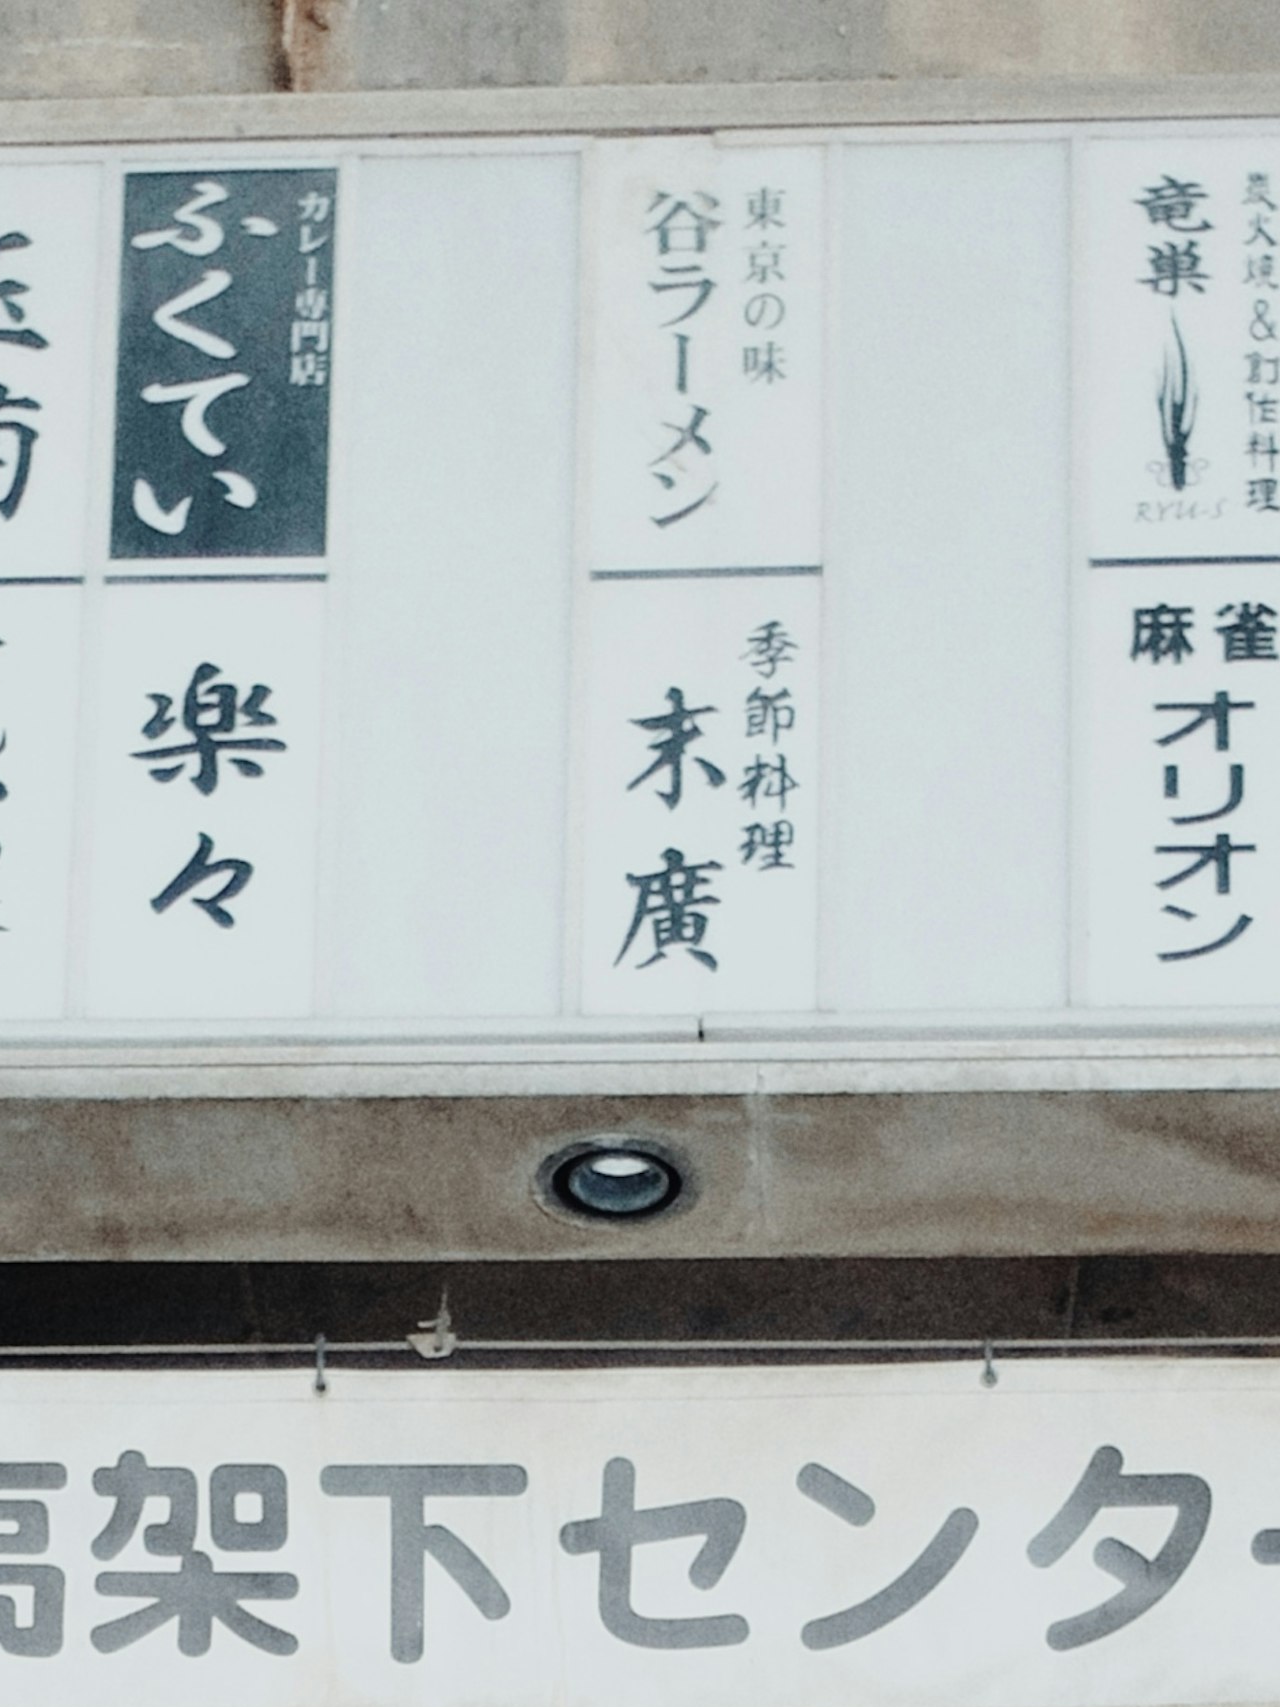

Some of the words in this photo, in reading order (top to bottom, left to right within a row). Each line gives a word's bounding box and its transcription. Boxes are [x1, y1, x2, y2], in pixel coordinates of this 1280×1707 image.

[131, 180, 280, 534] ふくてい
[290, 191, 331, 386] カレー専門店
[645, 190, 724, 529] 谷ラーメン
[743, 187, 786, 384] 東京の味
[1134, 175, 1213, 297] 竜巣
[737, 620, 800, 871] 季節料理
[1129, 601, 1280, 665] 麻雀
[130, 662, 287, 929] 楽々
[613, 686, 727, 972] 末廣
[1153, 690, 1257, 962] オリオン
